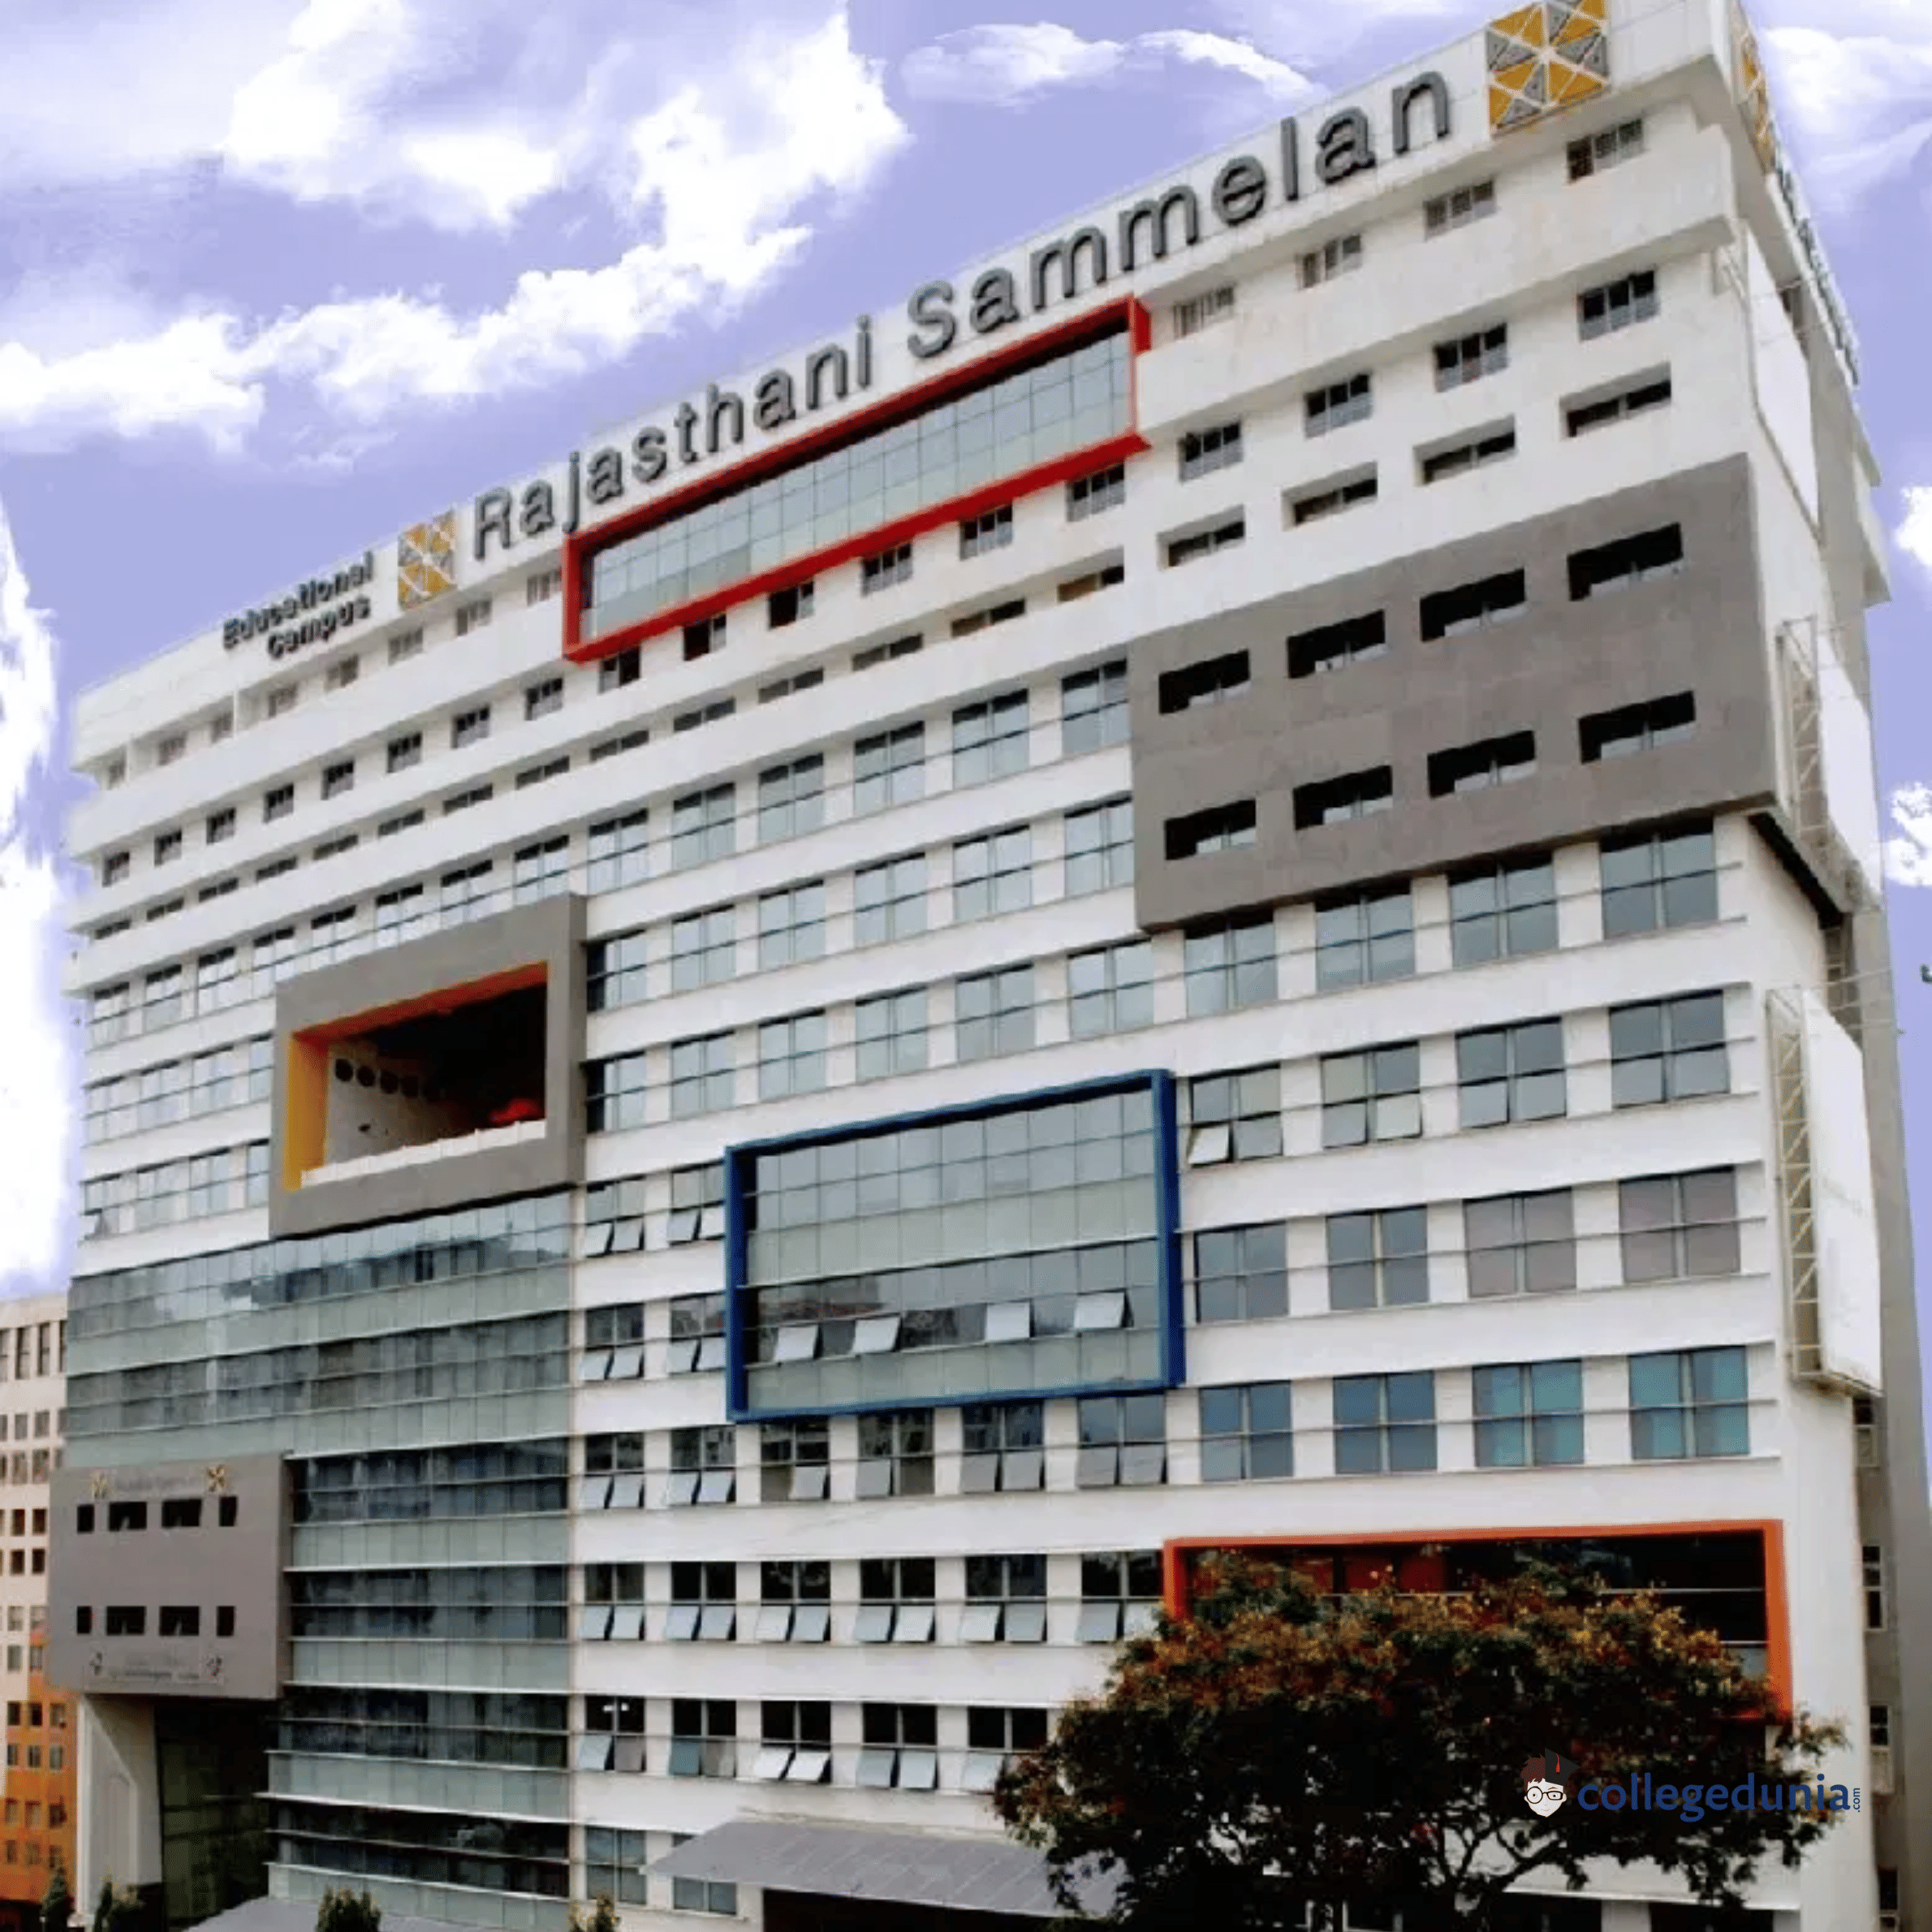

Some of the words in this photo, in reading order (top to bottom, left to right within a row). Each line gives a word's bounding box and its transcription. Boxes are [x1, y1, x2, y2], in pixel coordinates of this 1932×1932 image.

[473, 313, 872, 560] Rajasthani
[907, 70, 1451, 359] Sammelan
[223, 550, 373, 651] Educational
[268, 594, 371, 660] Campus
